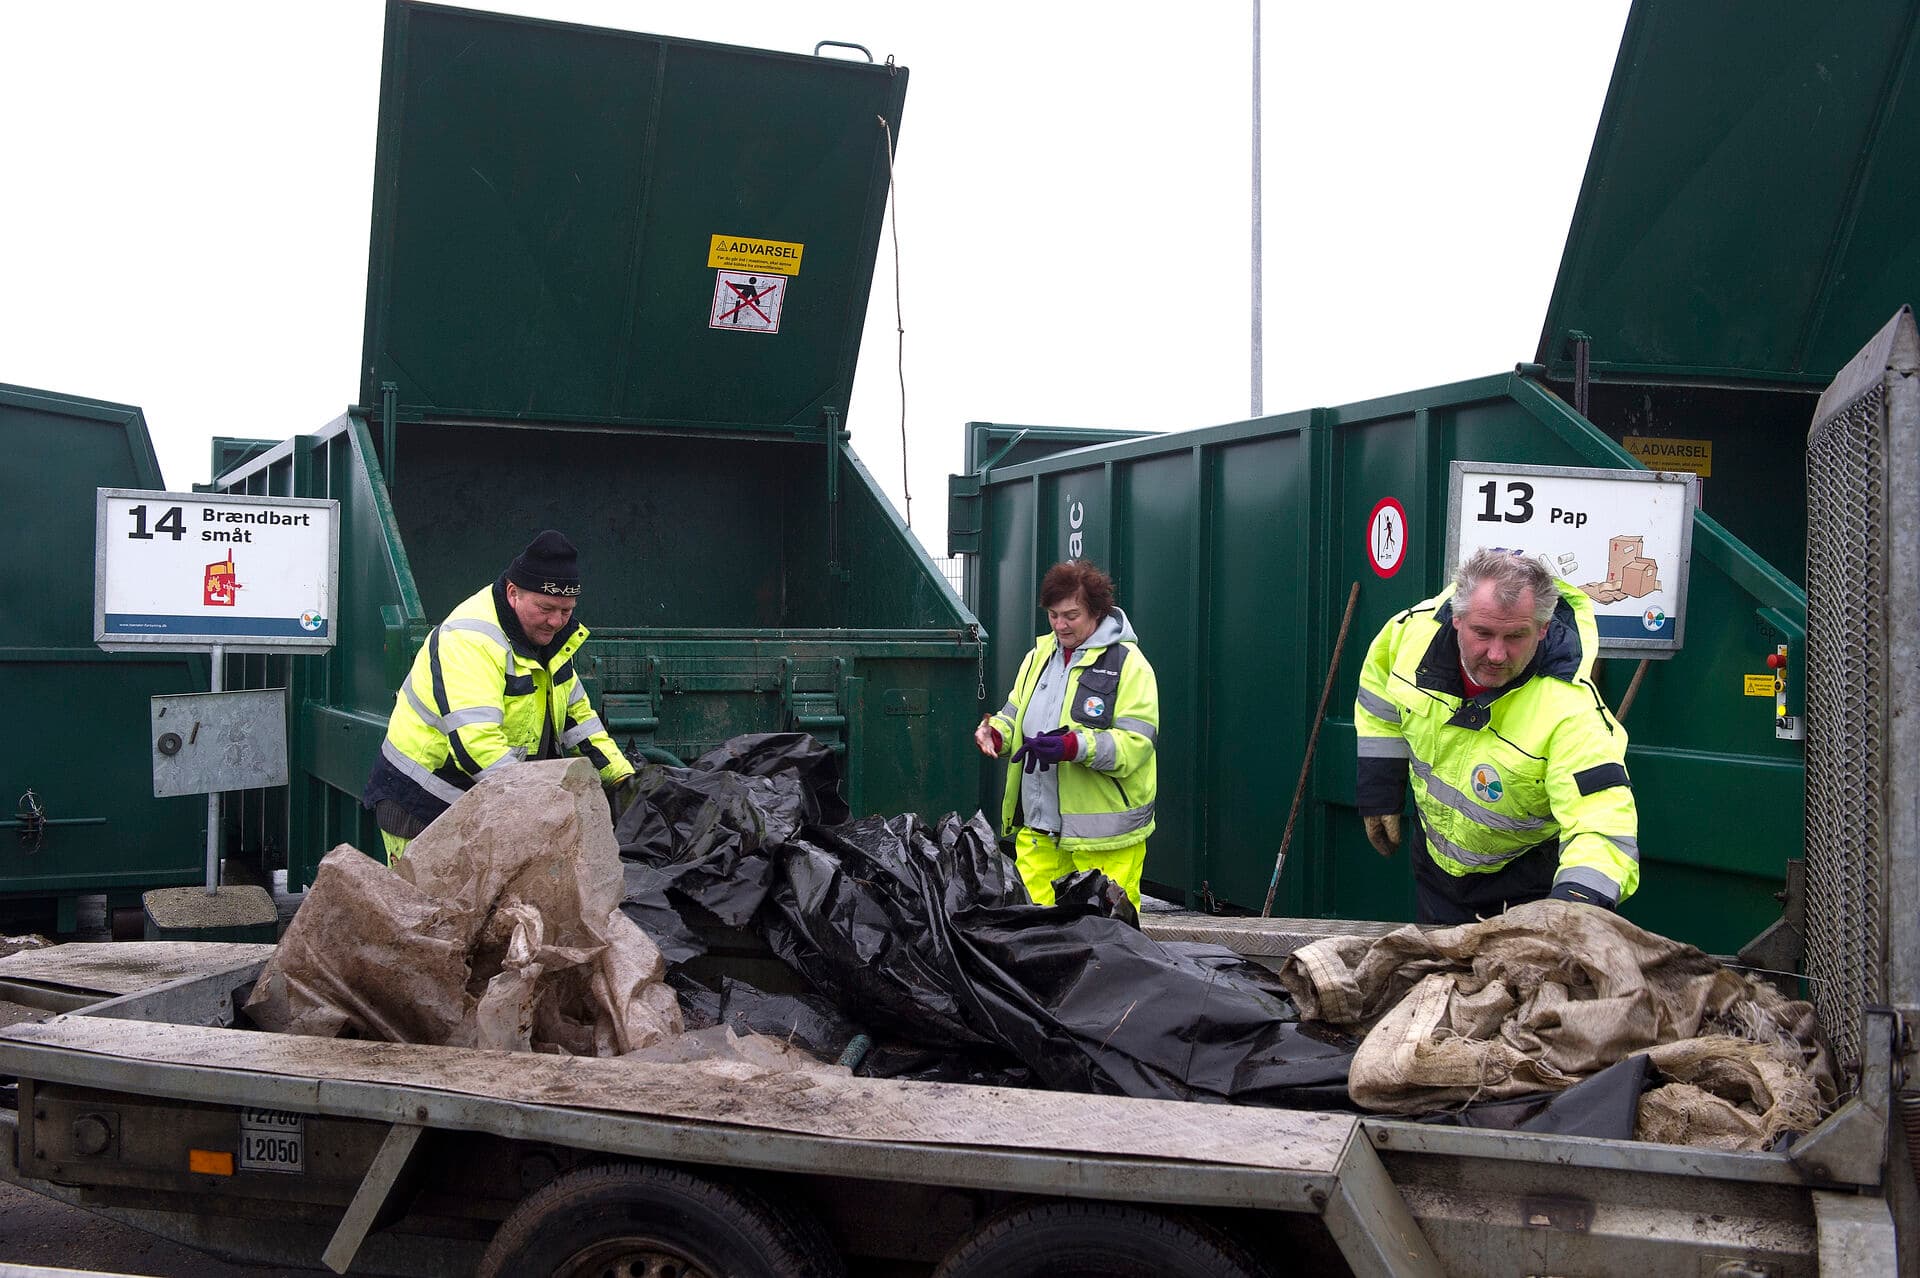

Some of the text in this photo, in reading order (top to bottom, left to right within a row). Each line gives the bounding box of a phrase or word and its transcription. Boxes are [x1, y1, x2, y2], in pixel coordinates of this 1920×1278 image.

[729, 242, 799, 259] ADVARSEL
[1641, 443, 1709, 458] ADVARSEL
[1477, 480, 1588, 529] 13 Pap
[128, 504, 310, 541] 14 Brændbart
[201, 527, 252, 543] småt
[246, 1137, 298, 1163] L2050
